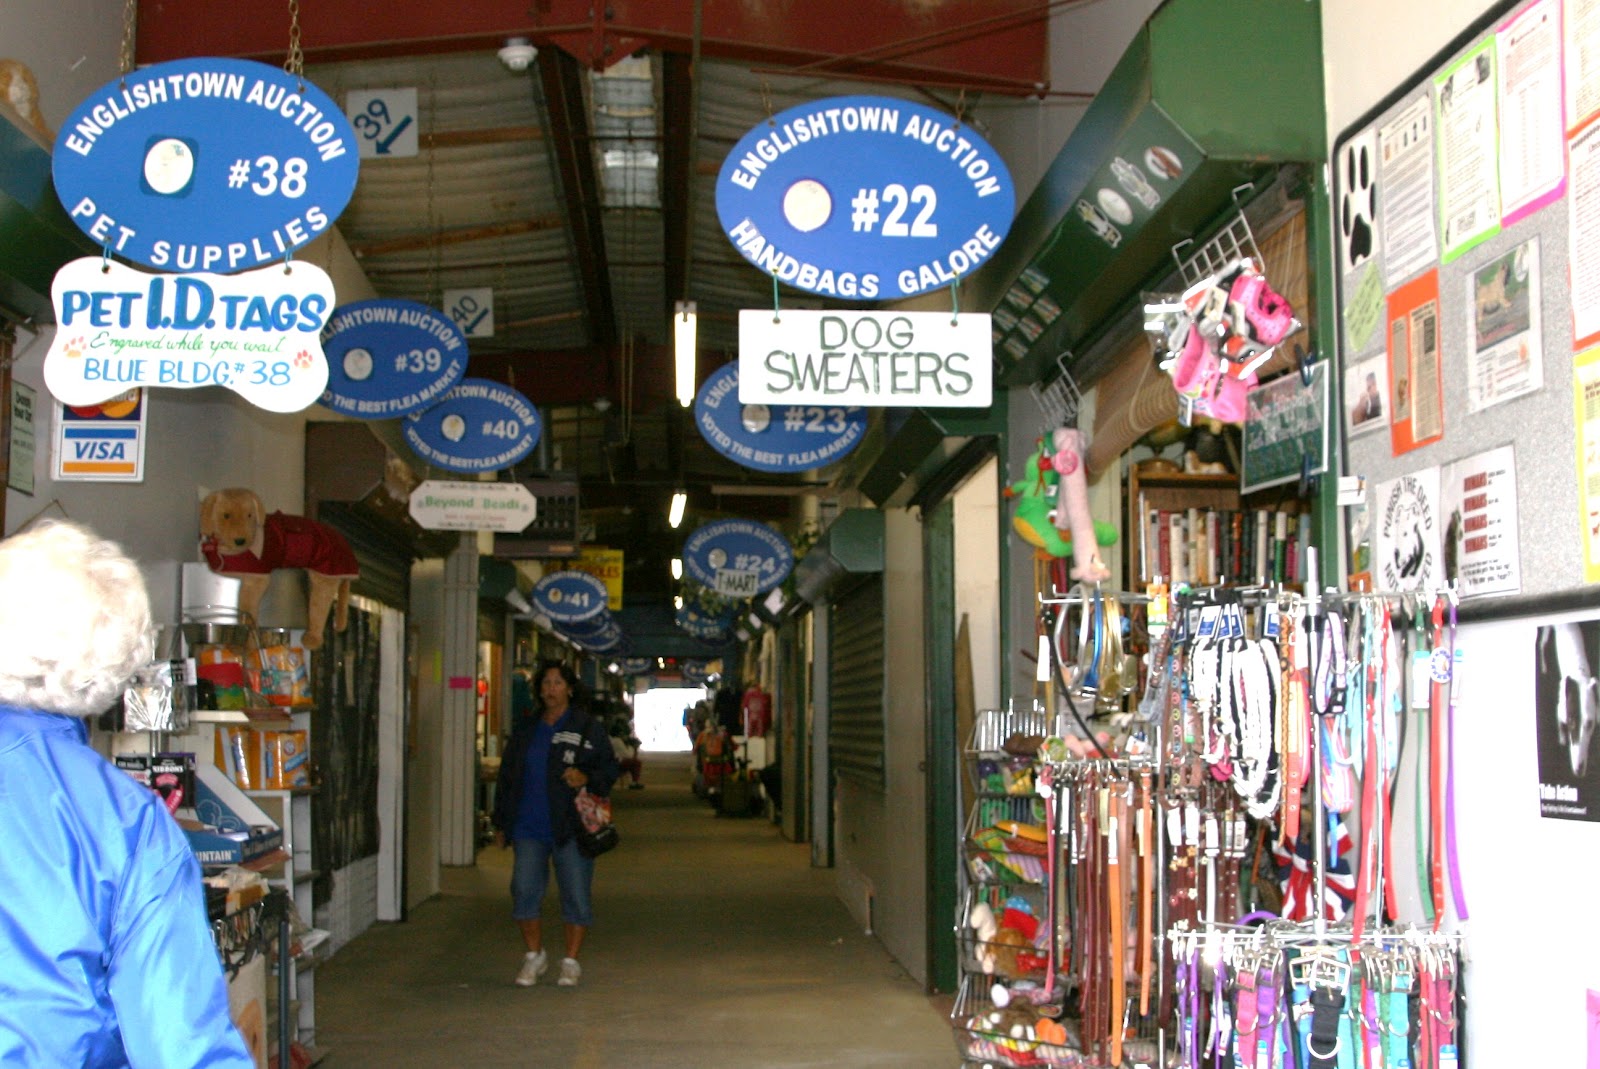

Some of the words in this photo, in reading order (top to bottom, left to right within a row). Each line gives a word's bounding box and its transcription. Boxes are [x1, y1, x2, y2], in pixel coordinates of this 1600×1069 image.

[65, 72, 245, 157] ENGLISHTOWN
[246, 80, 346, 162] AUCTION
[353, 98, 391, 140] 39
[730, 106, 899, 191] ENGLISHTOWN
[903, 115, 1001, 198] AUCTION
[228, 155, 308, 199] #38
[851, 183, 938, 238] #22
[71, 197, 136, 251] PET
[150, 206, 328, 269] SUPPLIES
[729, 219, 880, 298] HANDBAGS
[897, 223, 1001, 294] GALORE
[61, 290, 143, 329] PET
[146, 277, 216, 330] I.D.
[219, 293, 327, 333] TAGS
[89, 331, 163, 355] Engraved
[166, 332, 204, 351] while
[209, 339, 238, 358] you
[243, 335, 286, 353] wait
[320, 307, 398, 342] LISHTOWN
[401, 311, 461, 352] AUCTION
[820, 315, 914, 350] DOG
[83, 358, 148, 382] BLUE
[395, 348, 441, 374] #39
[763, 349, 973, 396] SWEATERS
[333, 394, 355, 411] THE
[358, 399, 388, 414] BEST
[390, 395, 420, 412] FLEA
[420, 358, 461, 404] MARKET
[704, 369, 740, 409] ENGLI
[488, 388, 536, 427] AUCTION
[784, 405, 847, 434] #23
[482, 419, 520, 440] #40
[701, 411, 732, 448] VOTED
[731, 440, 754, 460] THE
[754, 449, 785, 466] BEST
[788, 451, 819, 466] FLEA
[818, 420, 861, 459] MARKET
[74, 441, 126, 460] VISA
[431, 449, 450, 465] THE
[450, 456, 474, 469] BEST
[474, 456, 498, 469] FLEA
[497, 432, 533, 465] MARKET
[424, 495, 475, 510] Beyond
[482, 498, 520, 510] Beads
[1383, 480, 1402, 538] PUNISH
[1402, 477, 1417, 495] THE
[1416, 485, 1432, 531] DEED
[734, 553, 775, 574] #24
[195, 849, 232, 862] UNTAIN
